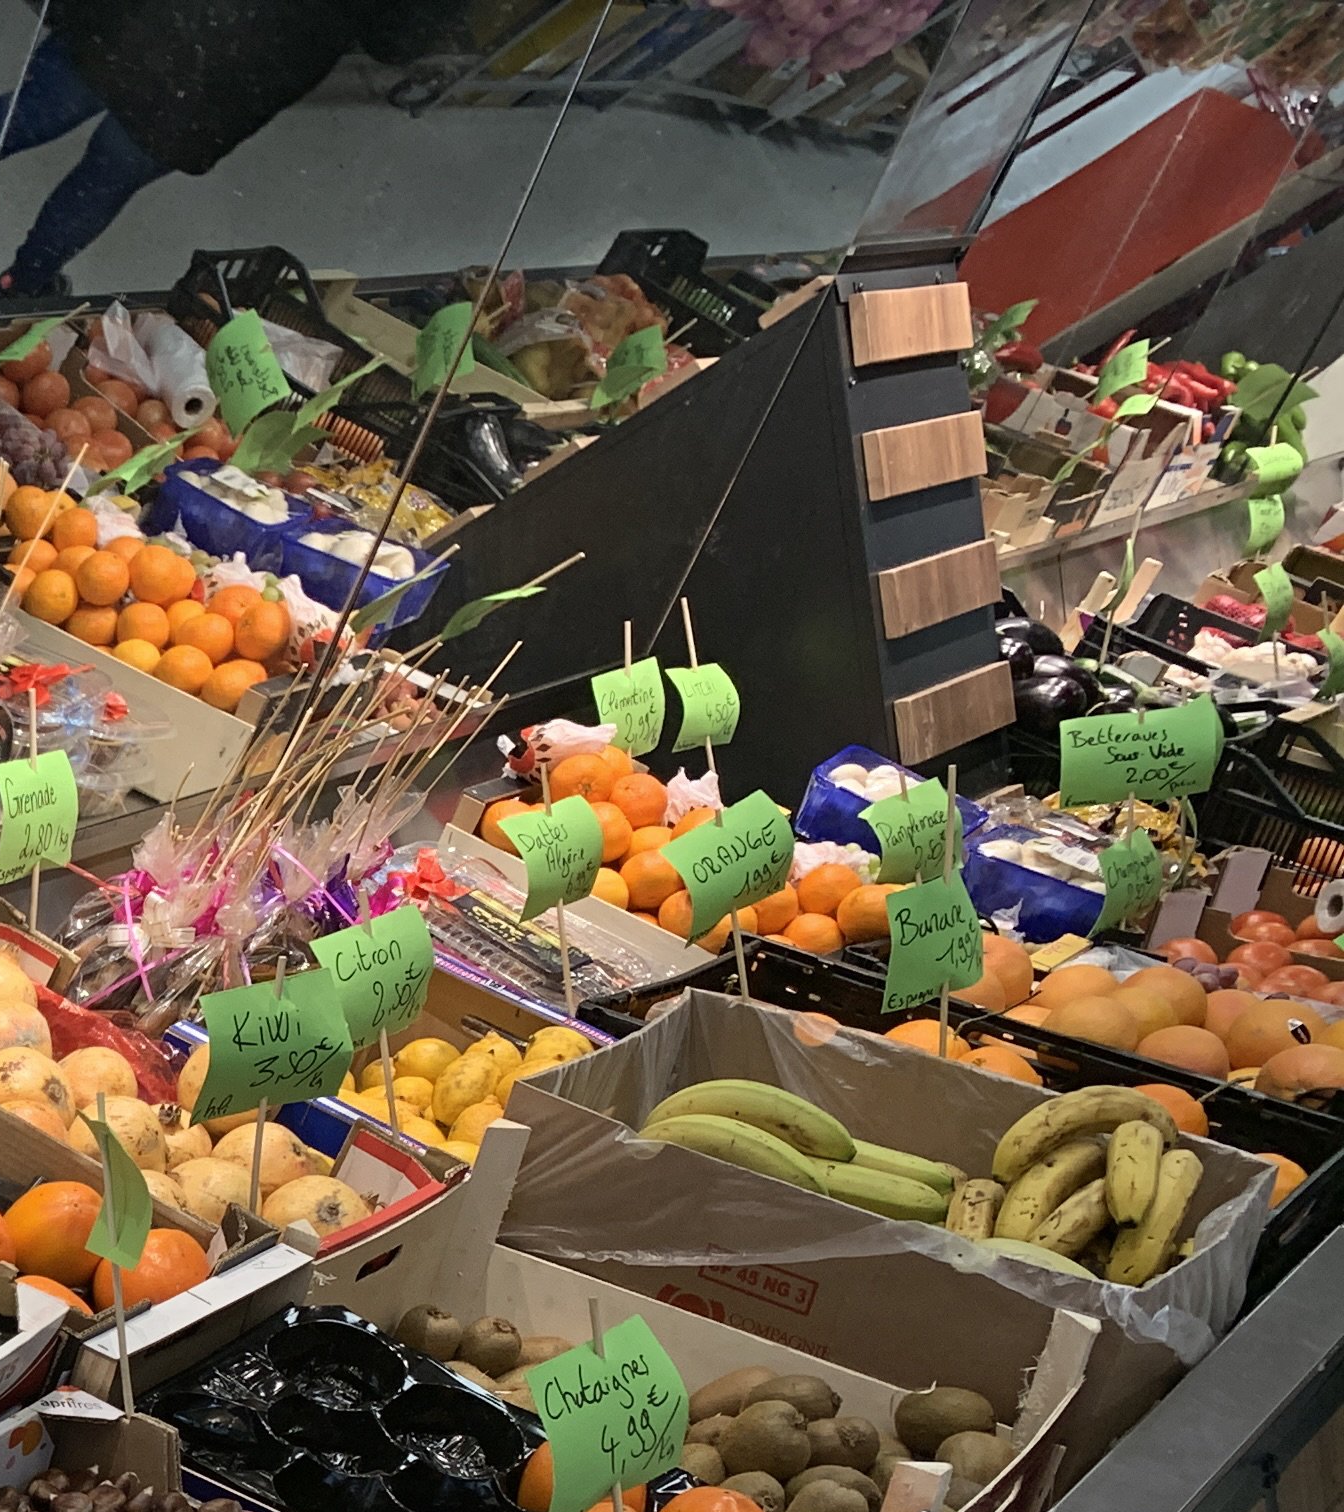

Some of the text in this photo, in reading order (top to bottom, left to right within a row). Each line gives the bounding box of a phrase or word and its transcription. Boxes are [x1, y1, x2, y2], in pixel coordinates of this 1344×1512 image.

[1067, 725, 1168, 749] Betteraves
[5, 777, 57, 819] Grenade
[518, 820, 568, 852] Dattes
[693, 818, 776, 883] ORANGE
[895, 904, 965, 947] Banane
[335, 939, 403, 982] Citron
[763, 1275, 791, 1297] NG
[794, 1287, 808, 1304] 3
[40, 1398, 104, 1411] aprifres
